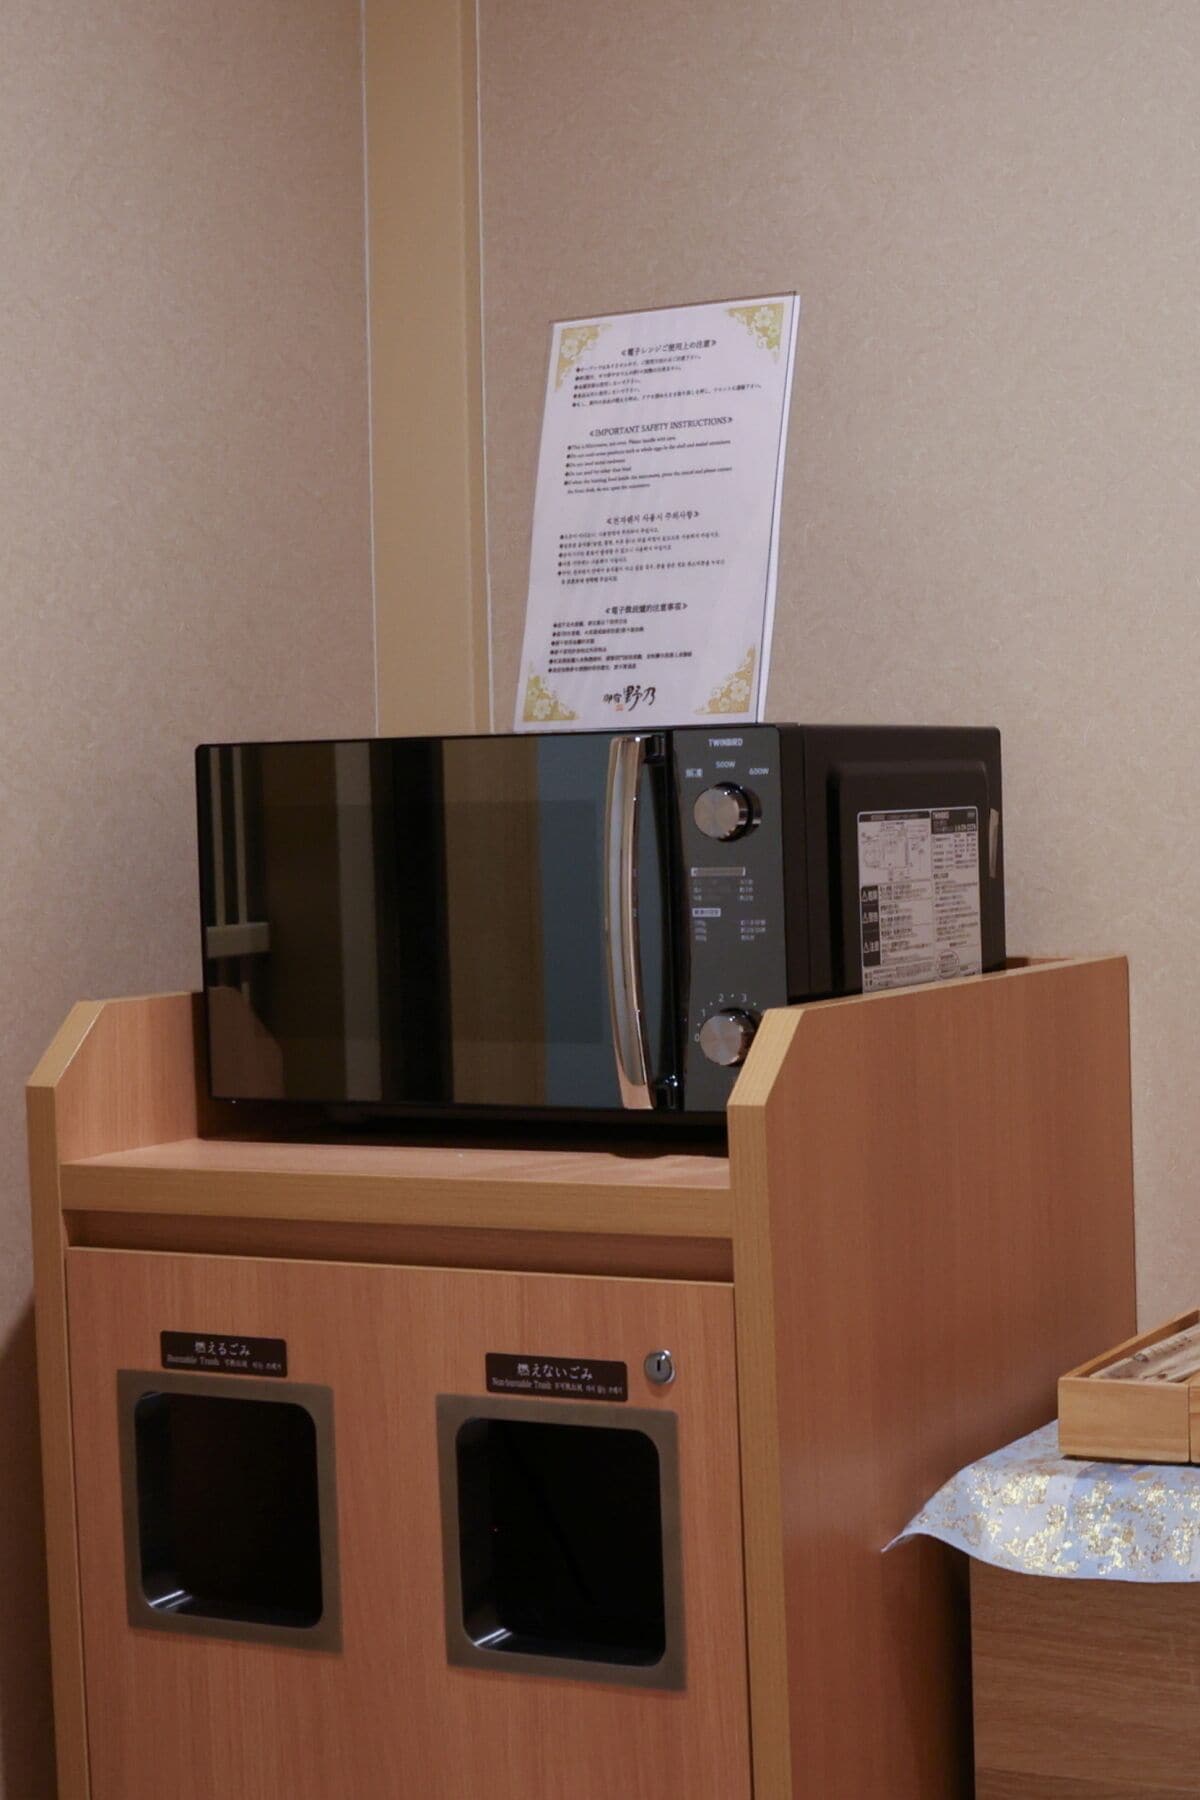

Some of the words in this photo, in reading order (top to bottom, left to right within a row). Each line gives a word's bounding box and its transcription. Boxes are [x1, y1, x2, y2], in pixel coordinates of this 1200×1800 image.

[641, 421, 670, 434] SAFETY
[708, 738, 743, 747] TWINBIRD
[715, 761, 736, 769] 500W
[749, 767, 769, 776] 600W
[194, 1341, 251, 1357] 燃えるごみ
[516, 1362, 593, 1380] 燃えないごみ
